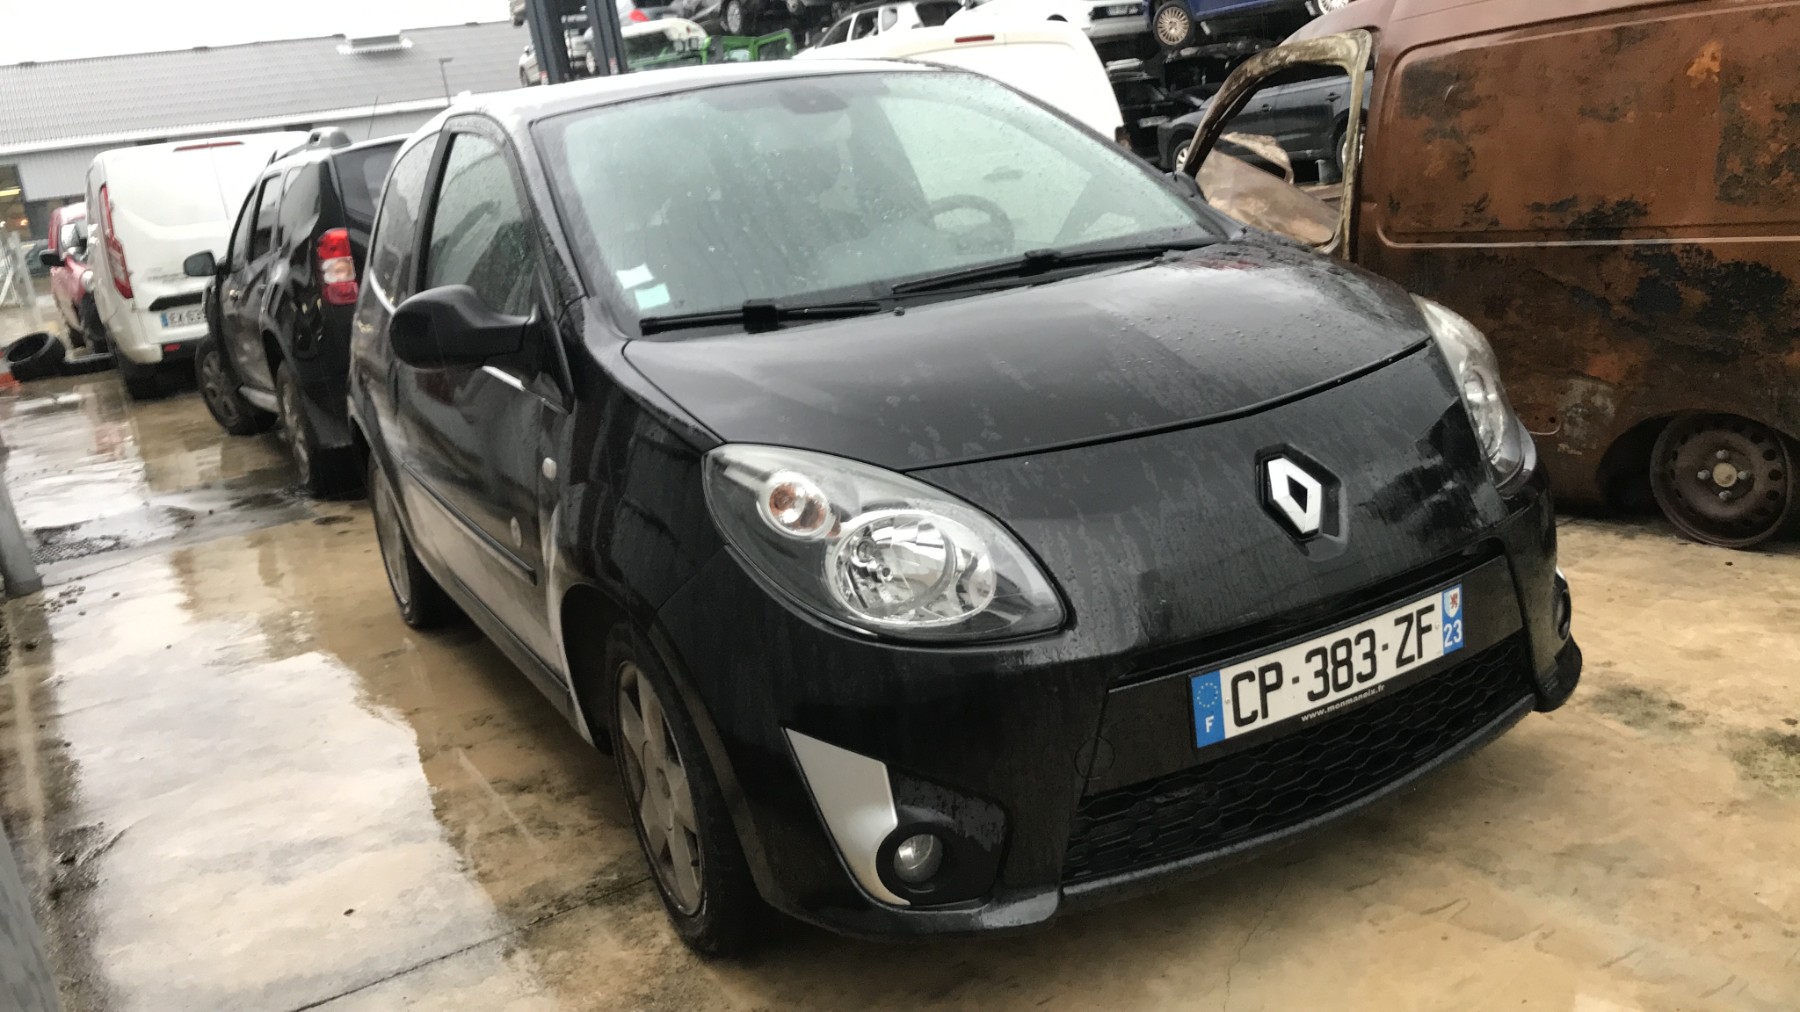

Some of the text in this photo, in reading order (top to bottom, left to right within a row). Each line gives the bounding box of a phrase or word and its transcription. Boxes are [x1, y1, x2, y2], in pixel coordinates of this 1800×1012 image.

[1443, 619, 1461, 648] 23
[1230, 604, 1435, 728] CP-383-ZF
[1205, 715, 1214, 733] F
